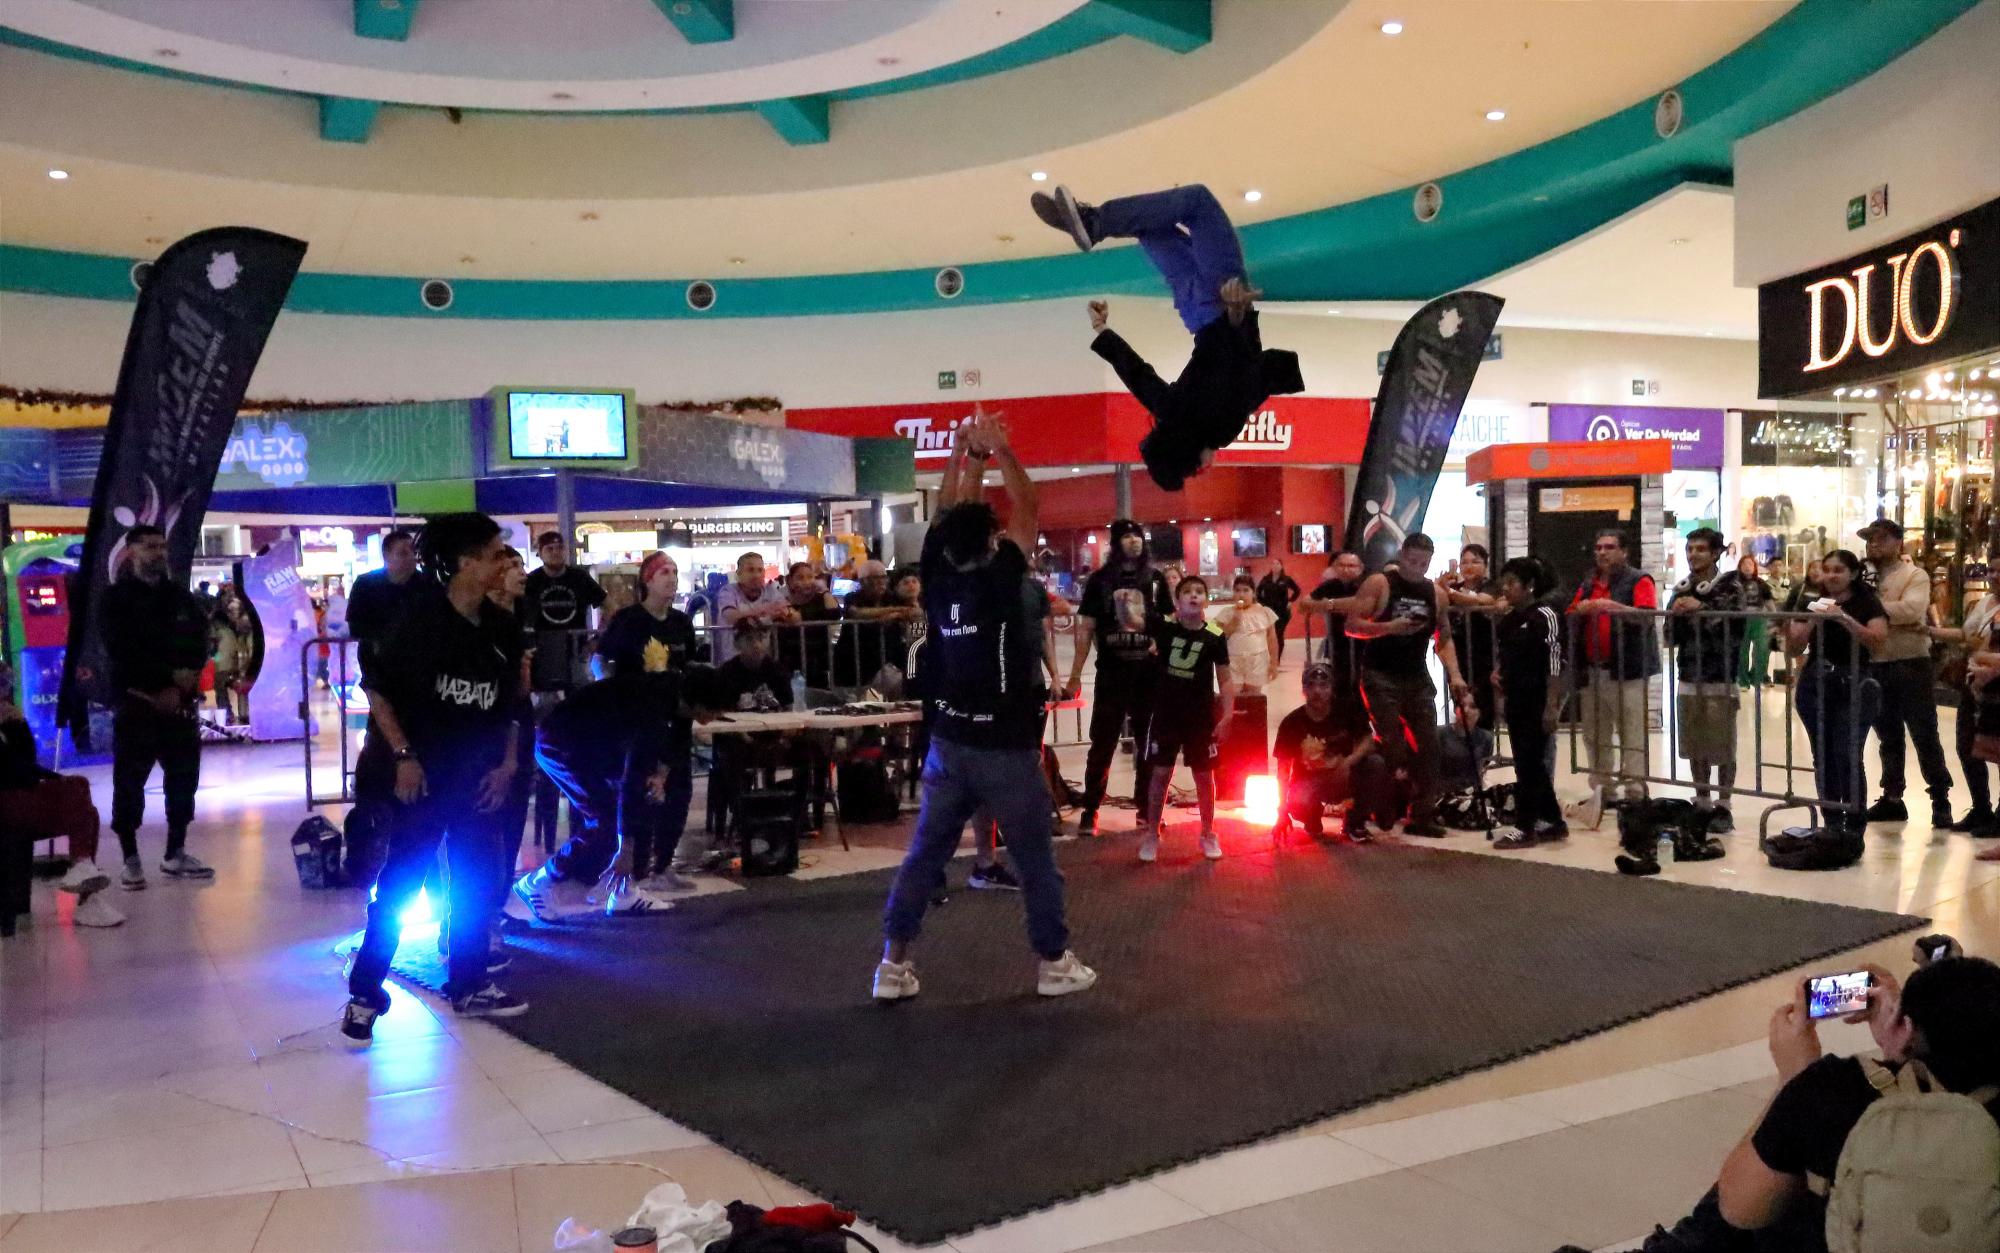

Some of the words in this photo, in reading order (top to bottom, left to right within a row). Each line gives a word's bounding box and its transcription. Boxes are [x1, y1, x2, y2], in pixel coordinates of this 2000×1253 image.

[1803, 242, 1952, 371] DUO
[895, 416, 974, 458] Thri
[1222, 411, 1292, 450] rifty
[1625, 429, 1644, 439] Ver
[1645, 429, 1660, 439] De
[1660, 429, 1700, 441] Verdad
[735, 439, 780, 464] GALEX
[689, 523, 741, 534] BURGER
[743, 522, 774, 533] KING
